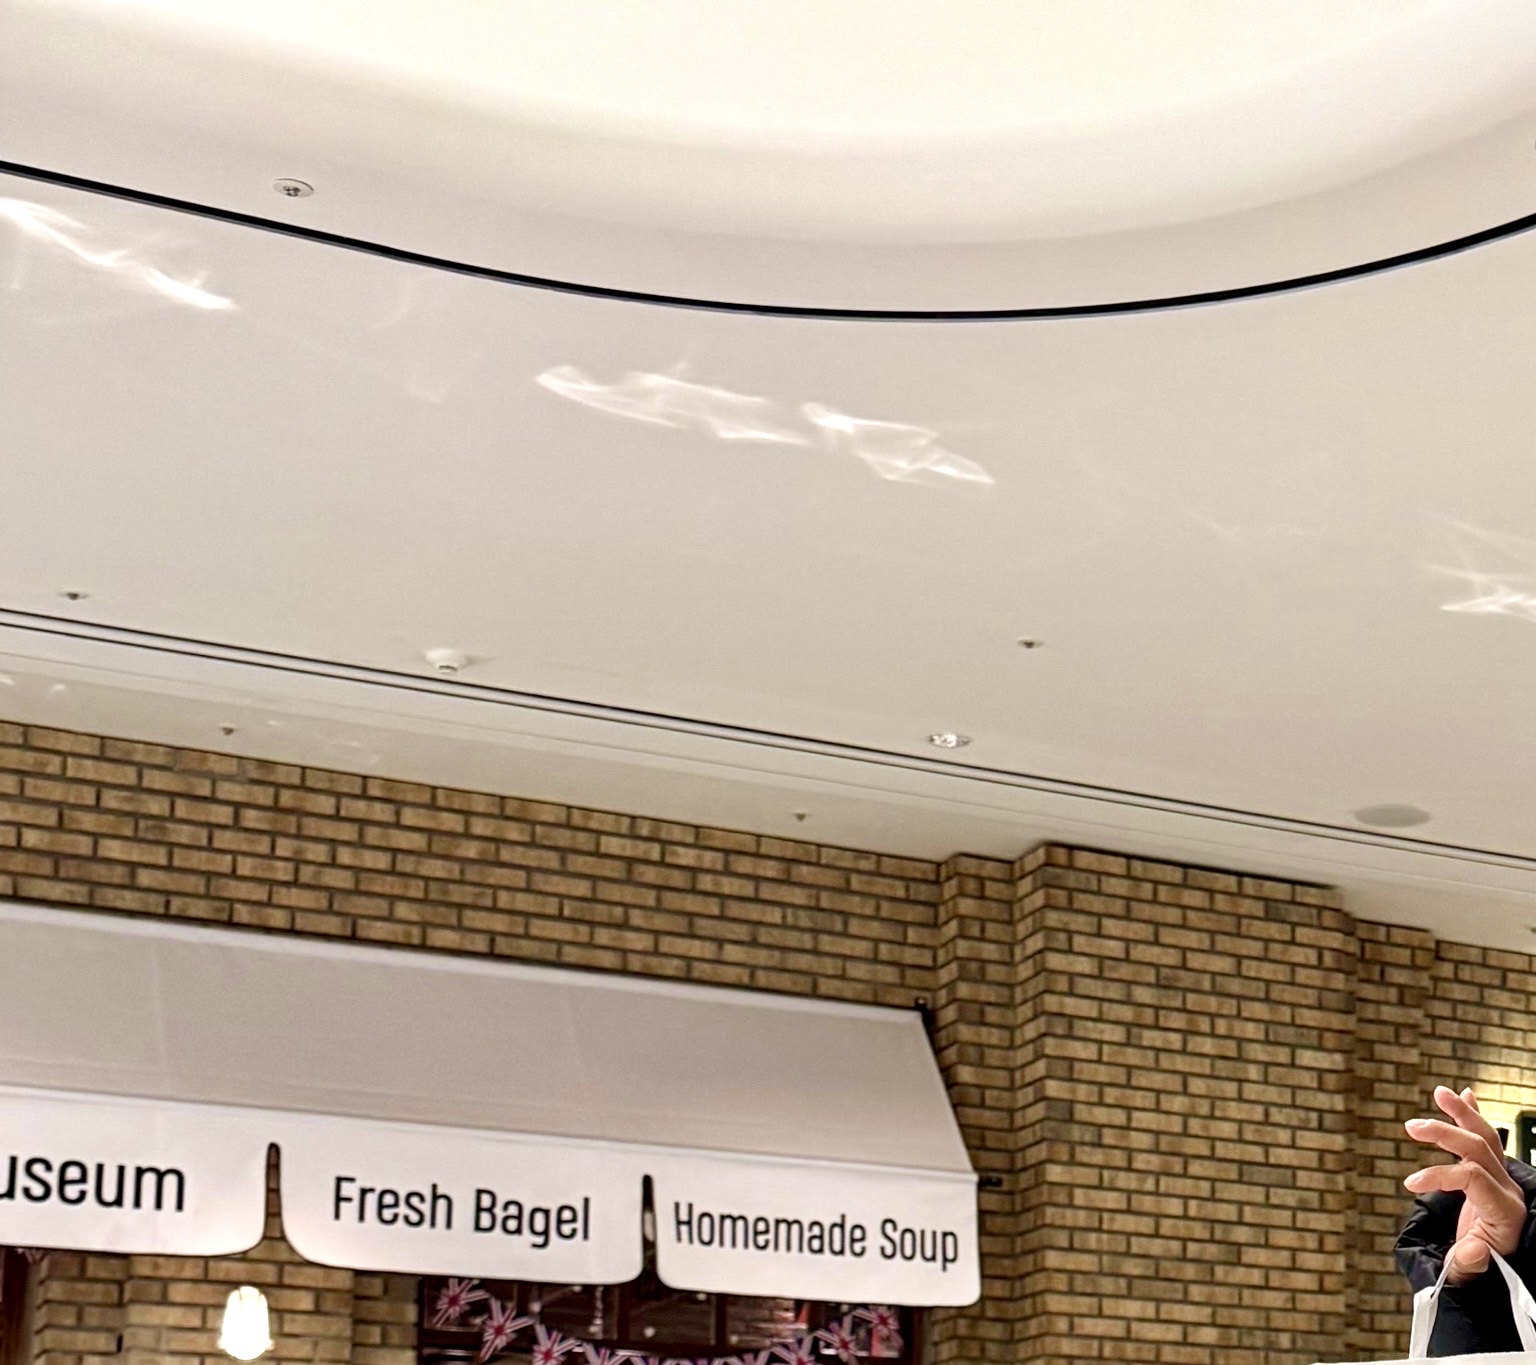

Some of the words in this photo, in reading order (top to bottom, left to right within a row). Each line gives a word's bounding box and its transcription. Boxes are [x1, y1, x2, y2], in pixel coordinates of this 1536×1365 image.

[333, 1176, 453, 1230] Fresh
[474, 1188, 590, 1249] Bagel
[674, 1201, 866, 1258] Homemade
[879, 1218, 958, 1272] Soup
